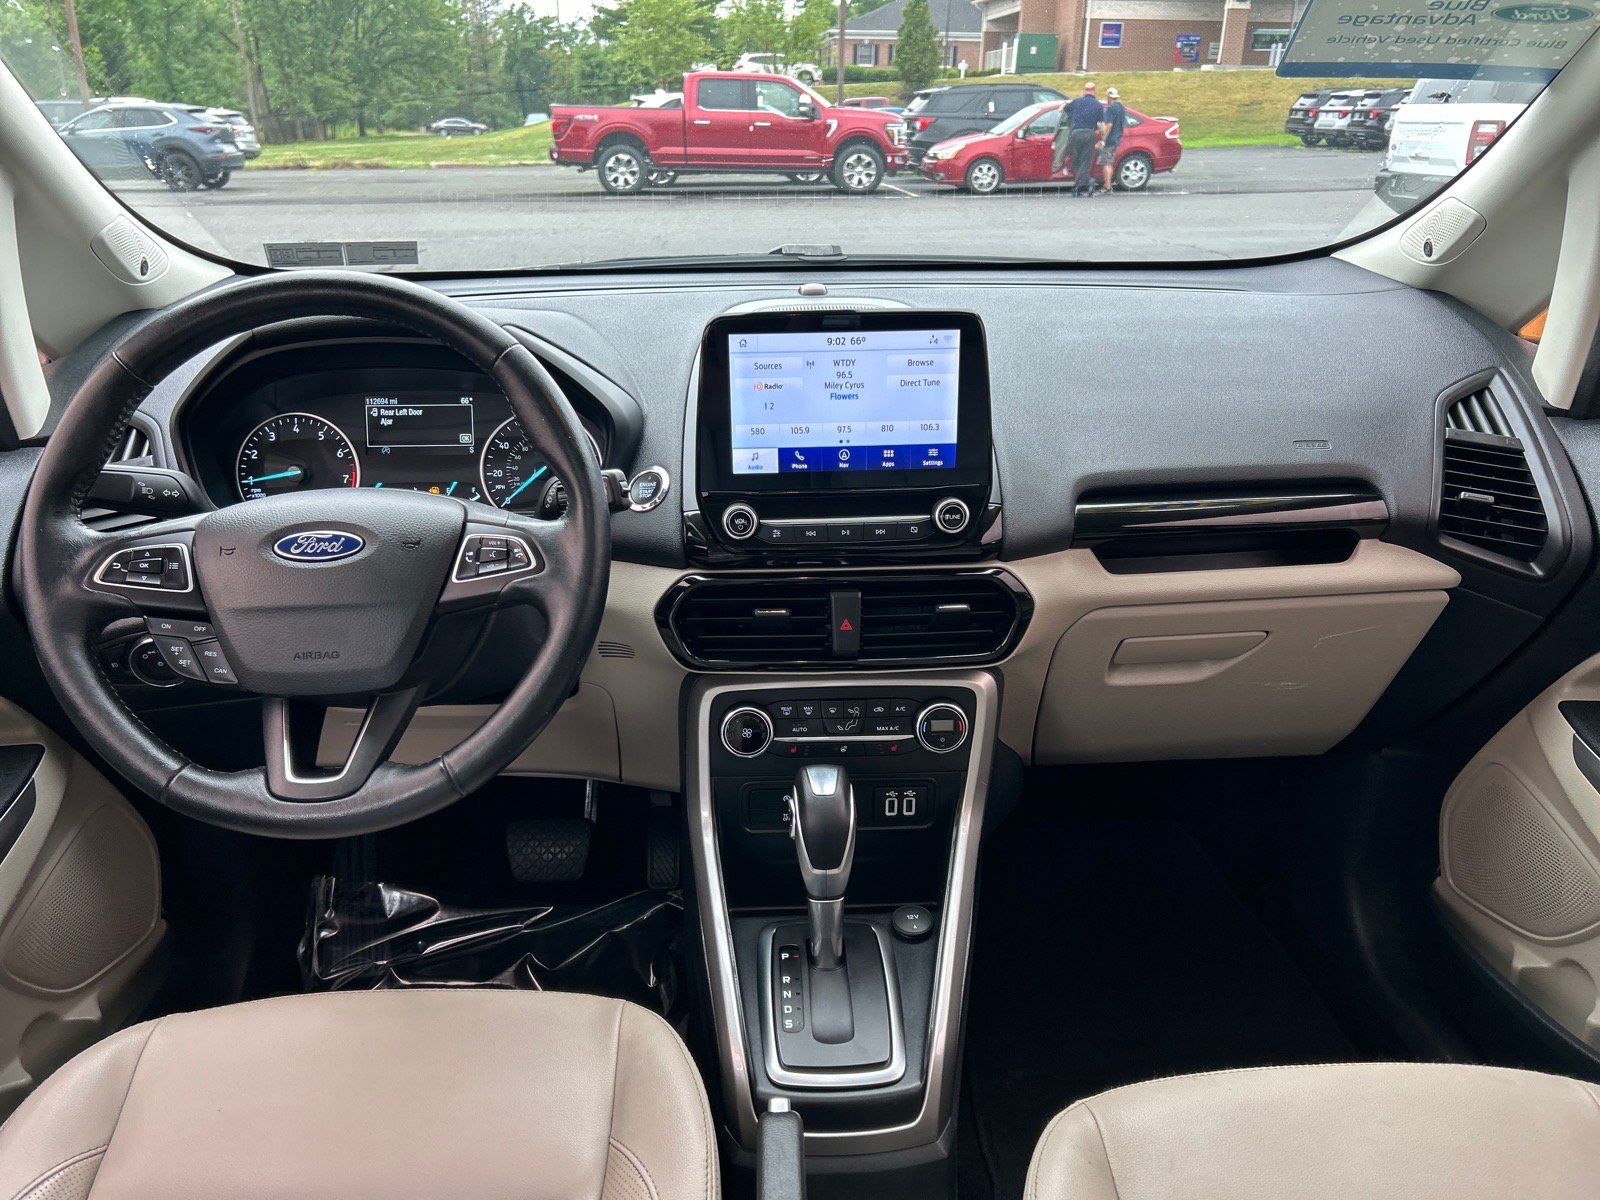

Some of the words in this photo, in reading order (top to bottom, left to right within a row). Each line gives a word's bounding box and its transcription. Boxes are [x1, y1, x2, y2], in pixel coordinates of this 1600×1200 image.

[826, 337, 846, 346] 9:02
[754, 362, 782, 370] Sources
[833, 359, 857, 367] WTDY
[907, 359, 934, 367] Browse
[836, 371, 853, 379] 96.5
[824, 382, 843, 390] Miley
[845, 381, 865, 390] Cyrus
[900, 379, 921, 387] Direct
[923, 379, 941, 387] Tune
[408, 408, 423, 416] Door
[380, 418, 393, 426] Ajar
[292, 425, 300, 434] 4
[750, 428, 765, 436] 580
[790, 427, 810, 435] 105.9
[837, 426, 852, 434] 97.5
[268, 432, 276, 441] 3
[318, 431, 325, 441] 5
[499, 441, 510, 450] 40
[251, 449, 259, 459] 2
[469, 446, 475, 454] S
[336, 451, 344, 459] 6
[493, 470, 503, 478] 20
[342, 475, 350, 485] 7
[293, 651, 340, 661] AIRBAG
[782, 952, 790, 960] P
[782, 976, 791, 984] R
[783, 991, 792, 999] N
[784, 1005, 792, 1013] D
[785, 1019, 793, 1029] S
